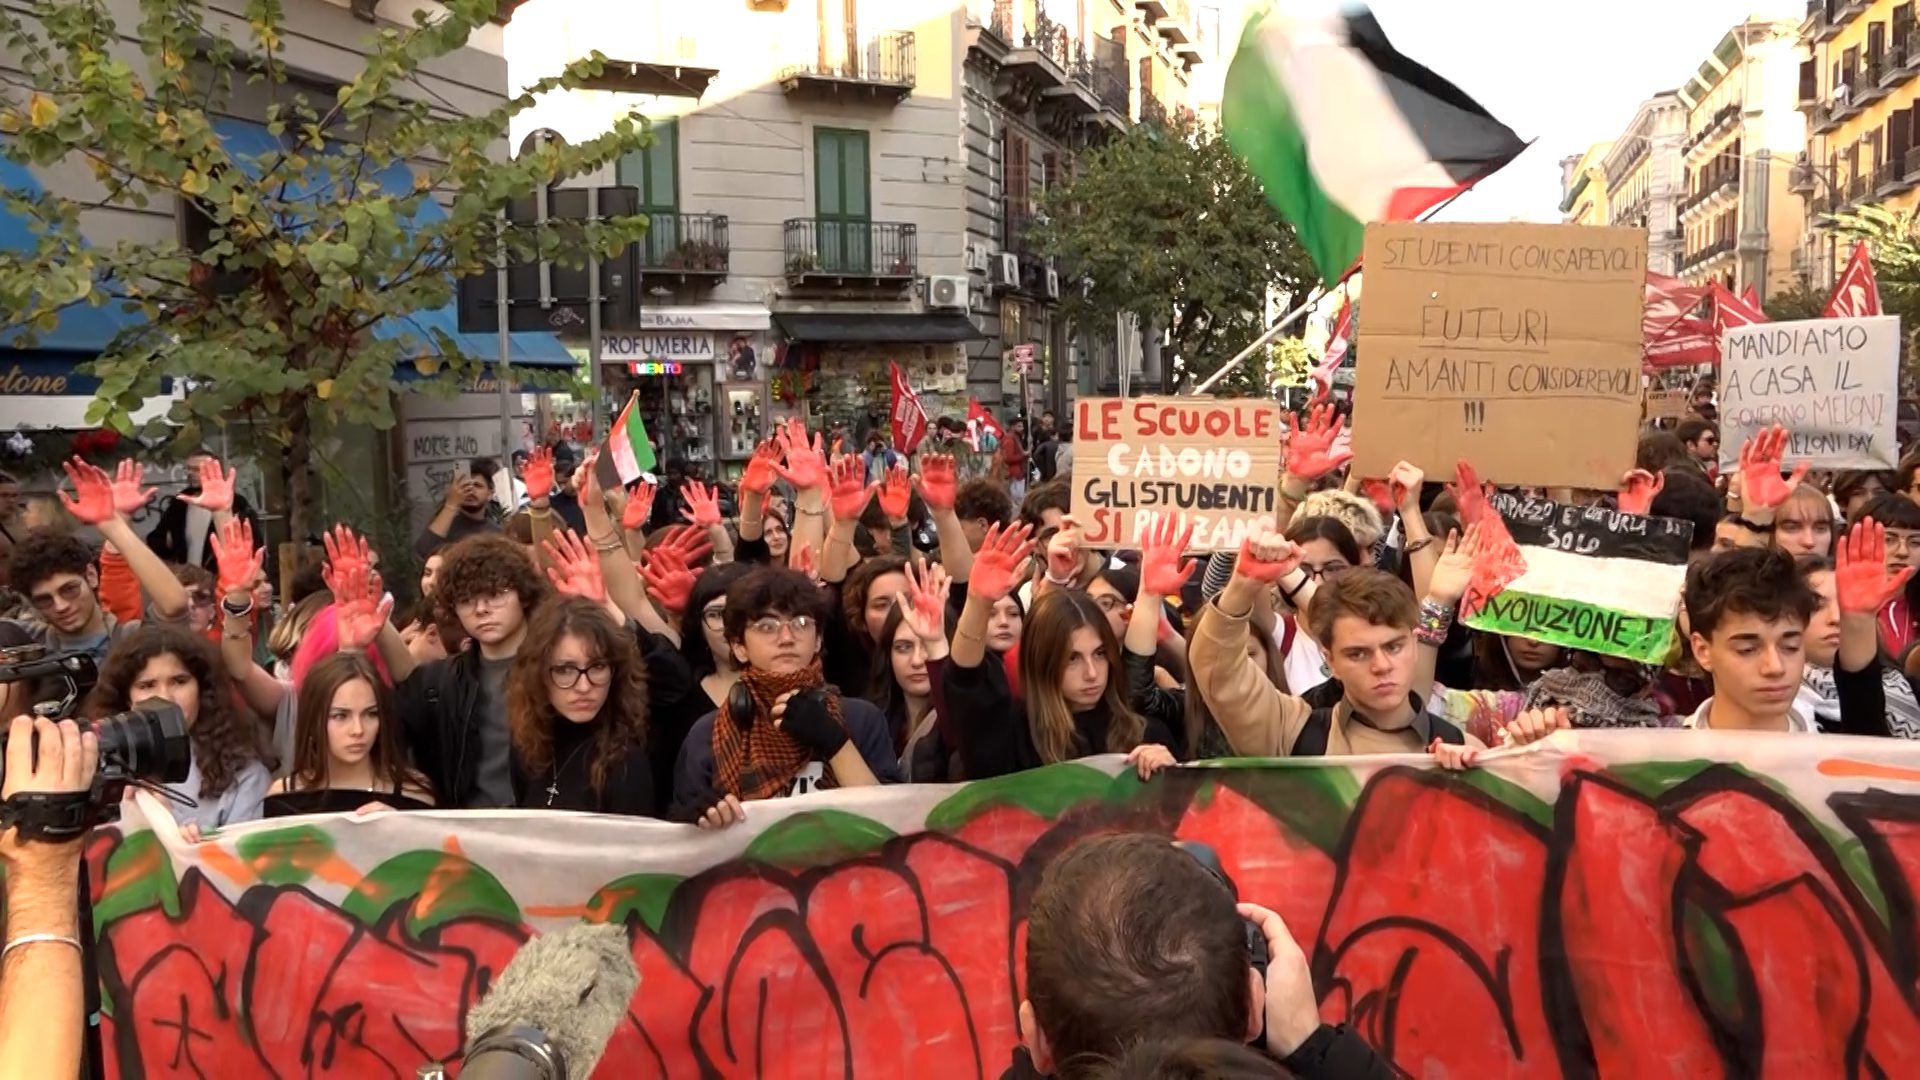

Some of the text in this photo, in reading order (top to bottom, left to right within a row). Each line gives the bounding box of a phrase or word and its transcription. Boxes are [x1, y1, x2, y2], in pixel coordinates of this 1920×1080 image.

[1384, 239, 1639, 273] STUDENTI CONSAPEVOLI
[1422, 305, 1549, 346] FUTURI
[1728, 325, 1868, 360] MANDIAMO
[600, 336, 712, 354] PROFUMERIA
[1385, 358, 1639, 396] AMANTI CONSIDEREVOLI
[1723, 360, 1863, 402] A CASA IL
[1079, 401, 1272, 441] LE SCUOLE
[1464, 401, 1485, 432] !!!
[1723, 393, 1884, 430] GOVERNO MELONI
[1107, 443, 1251, 479] CADONO
[1084, 478, 1274, 512] GLI STUDENTI
[1084, 507, 1122, 543] SI
[1547, 526, 1600, 553] SOLO
